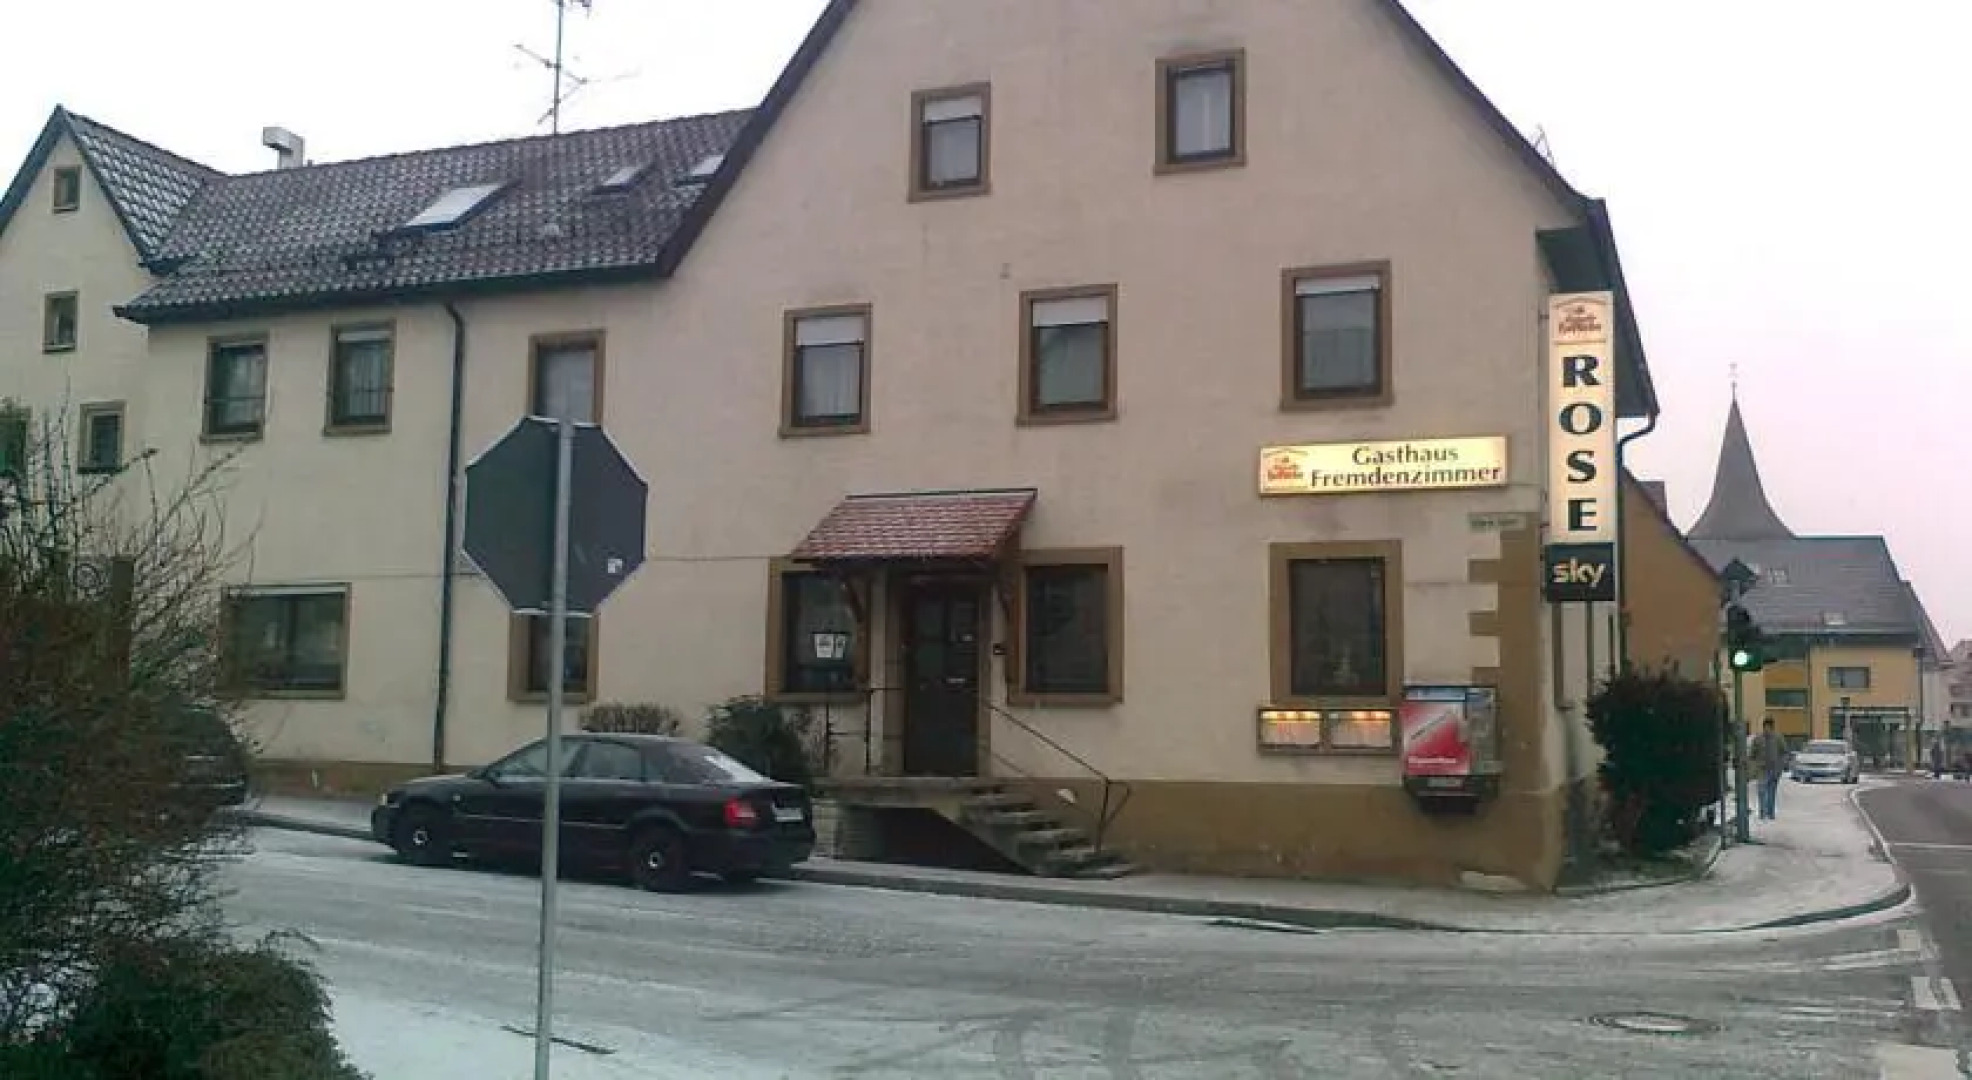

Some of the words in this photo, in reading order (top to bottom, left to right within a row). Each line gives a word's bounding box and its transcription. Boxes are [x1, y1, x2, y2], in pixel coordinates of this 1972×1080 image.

[1352, 444, 1459, 465] Gasthaus
[1559, 354, 1602, 531] ROSE
[1311, 466, 1502, 487] Fremdenzimmer
[1552, 557, 1605, 587] sky
